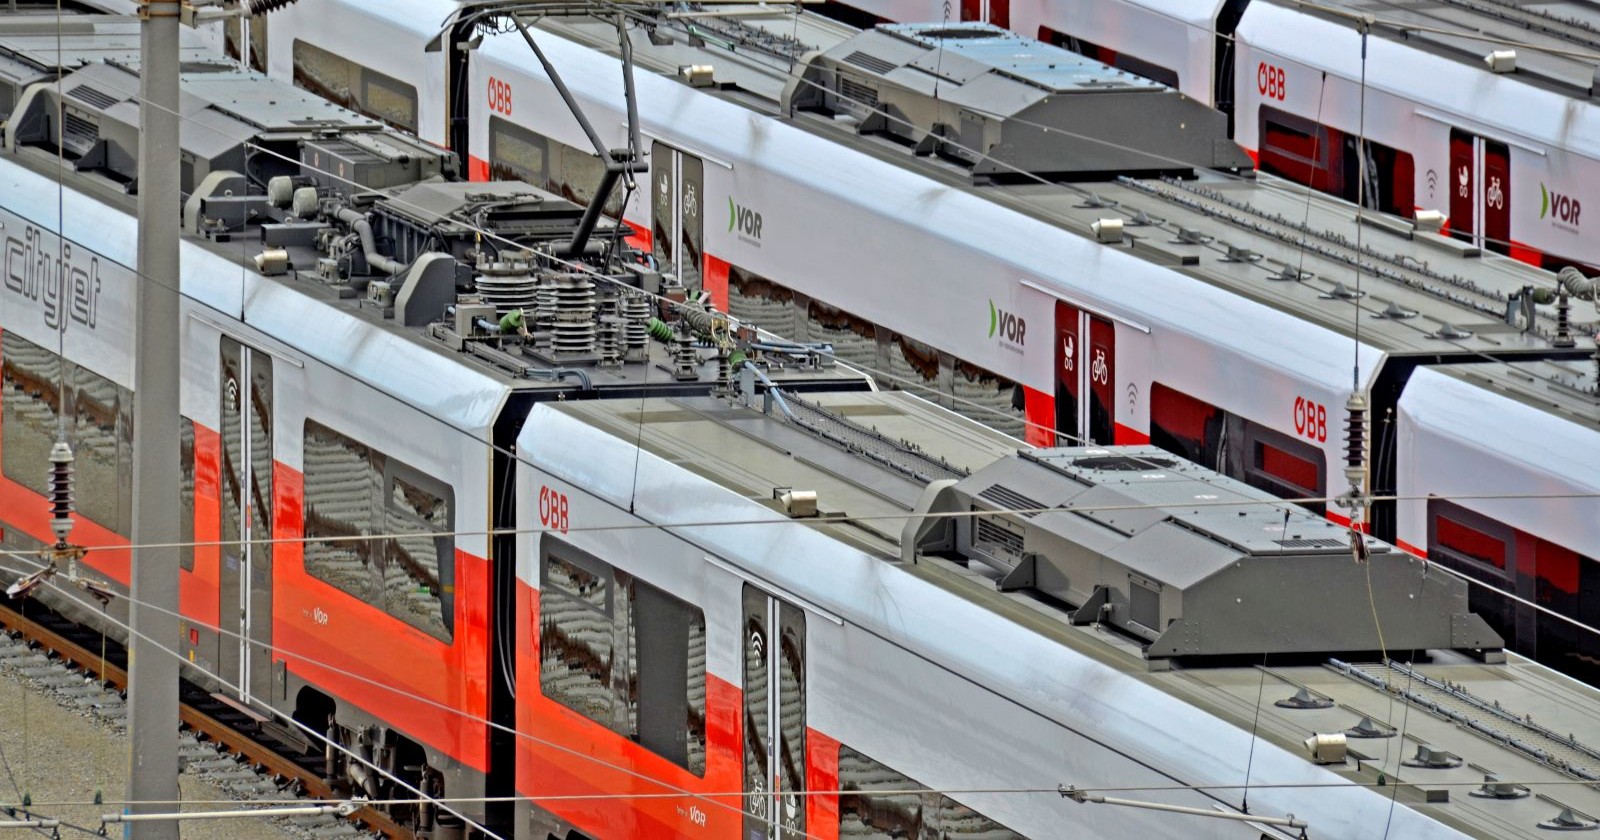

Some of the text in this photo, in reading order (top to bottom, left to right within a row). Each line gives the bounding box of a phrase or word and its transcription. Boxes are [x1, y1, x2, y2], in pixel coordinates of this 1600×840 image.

[488, 76, 512, 116] ÖBB
[1258, 61, 1285, 101] ÖBB
[737, 204, 762, 239] VOR
[1551, 191, 1580, 225] VOR
[5, 225, 101, 333] cityjet
[998, 309, 1026, 346] VOR
[1294, 396, 1327, 443] ÖBB
[540, 485, 568, 534] ÖBB
[314, 607, 328, 625] VOR
[690, 805, 706, 827] VOR
